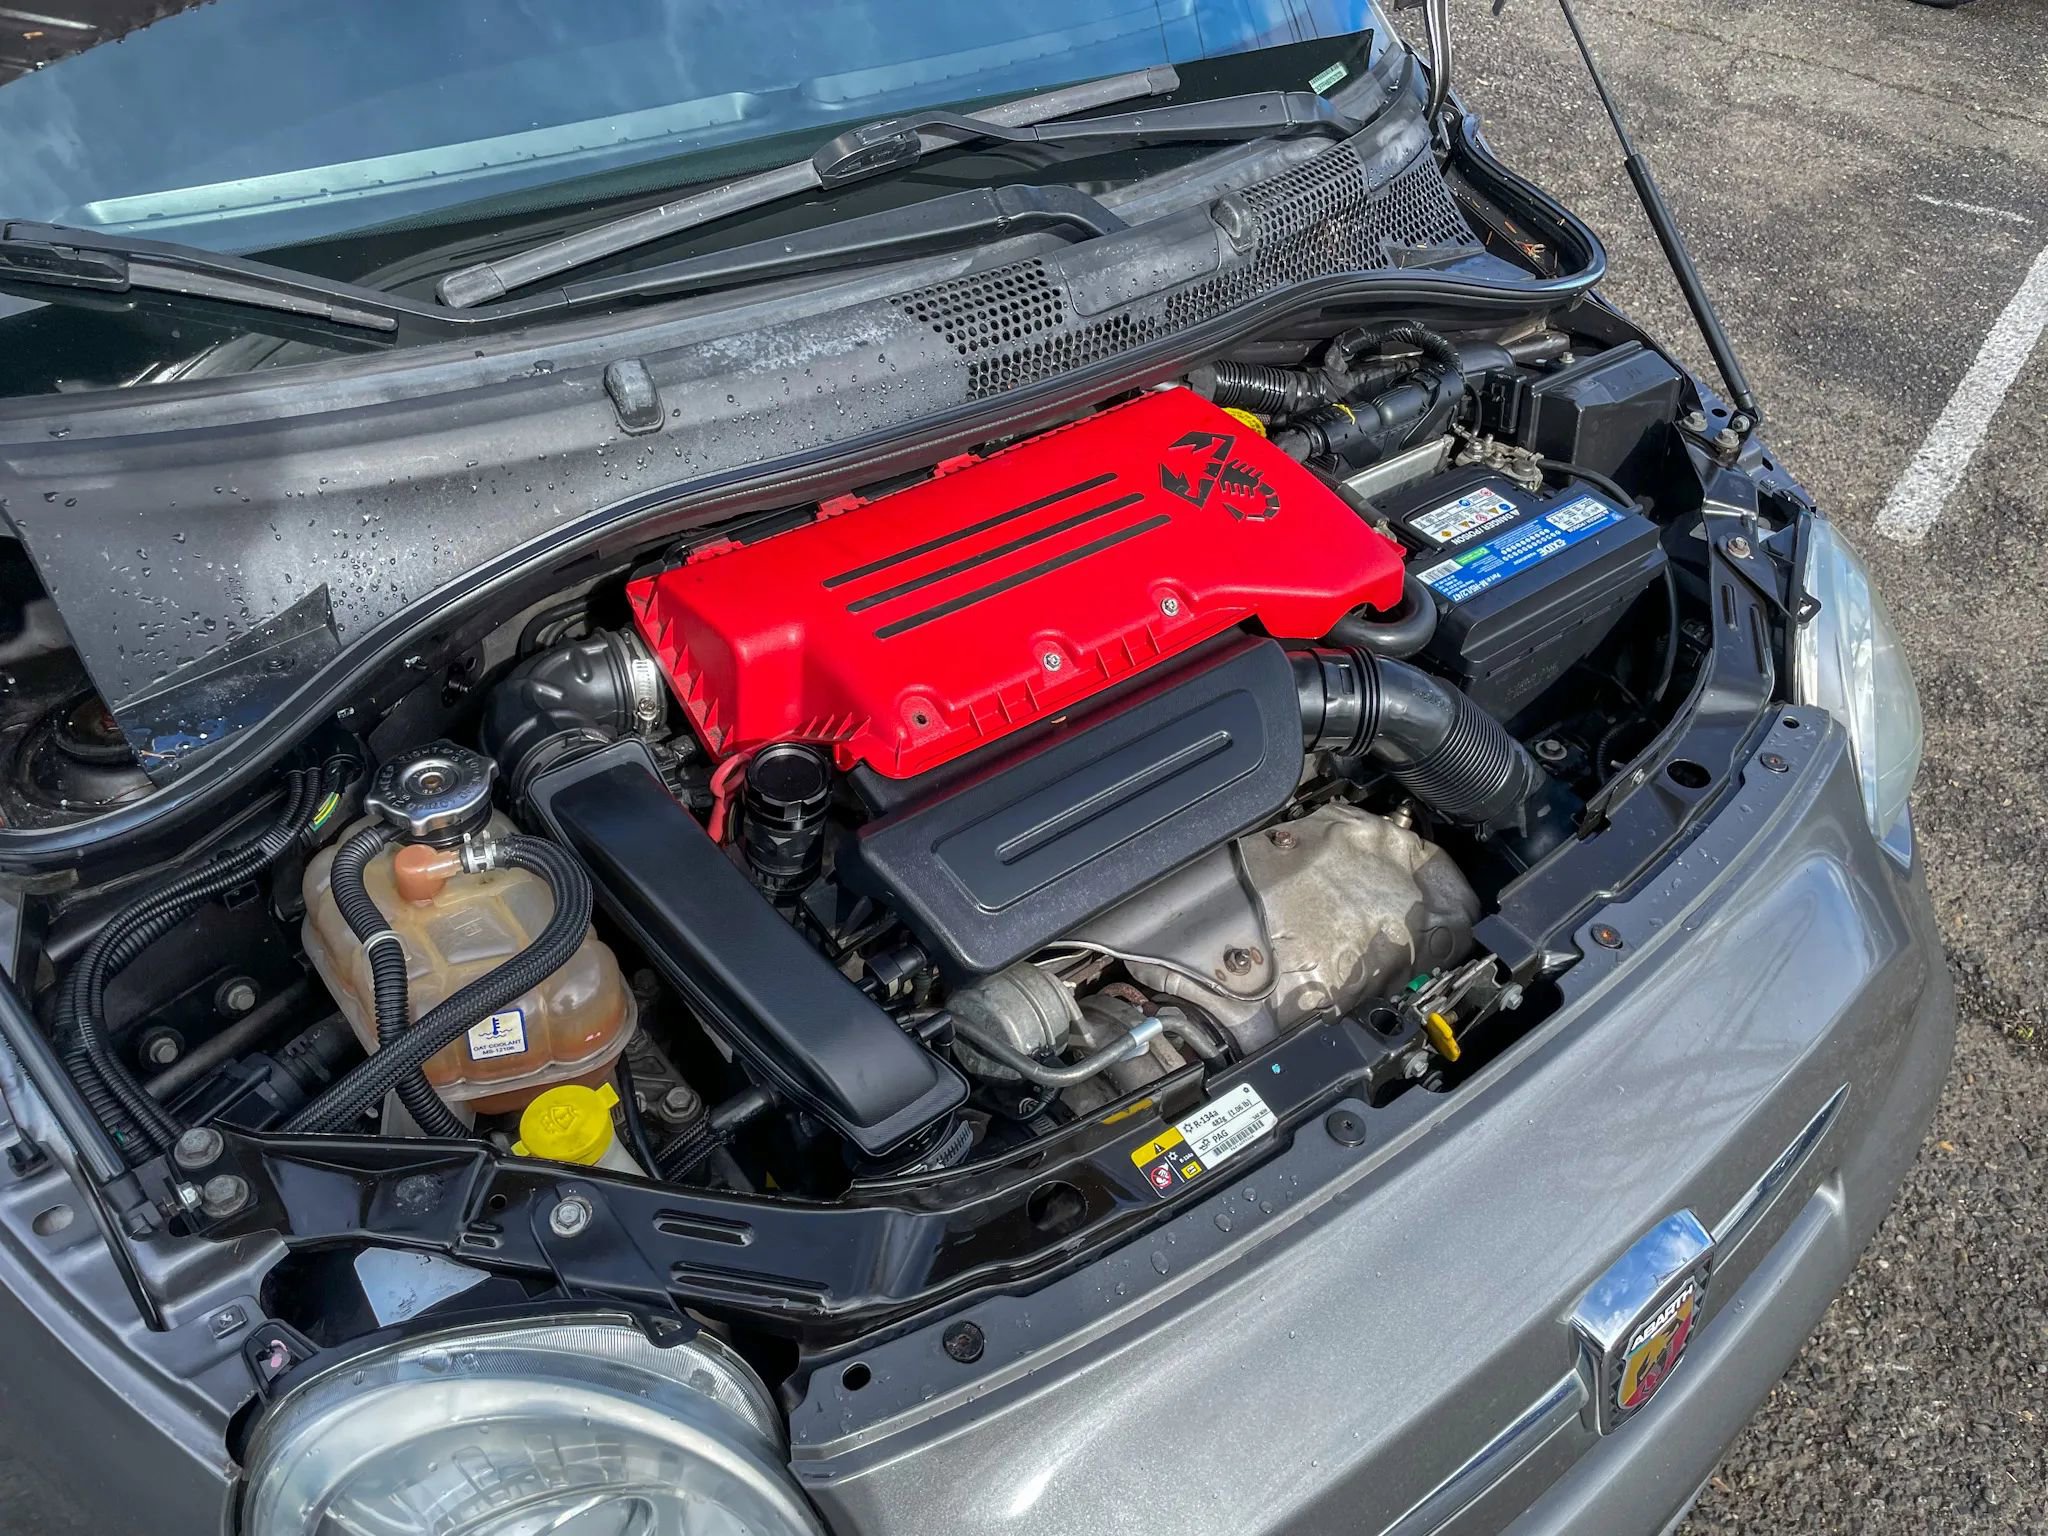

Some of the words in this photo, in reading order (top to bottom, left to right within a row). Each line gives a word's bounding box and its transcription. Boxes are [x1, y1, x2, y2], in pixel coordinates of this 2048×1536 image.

[1481, 513, 1513, 529] DANGER
[1450, 528, 1479, 544] POISON
[1536, 538, 1566, 556] EXIDE
[488, 1039, 521, 1048] COOLANT
[1194, 1110, 1218, 1128] R-134a
[1212, 1116, 1227, 1127] 482g
[1241, 1098, 1252, 1108] lb)
[1212, 1130, 1228, 1143] PAG
[1631, 1285, 1693, 1350] ABARTH
